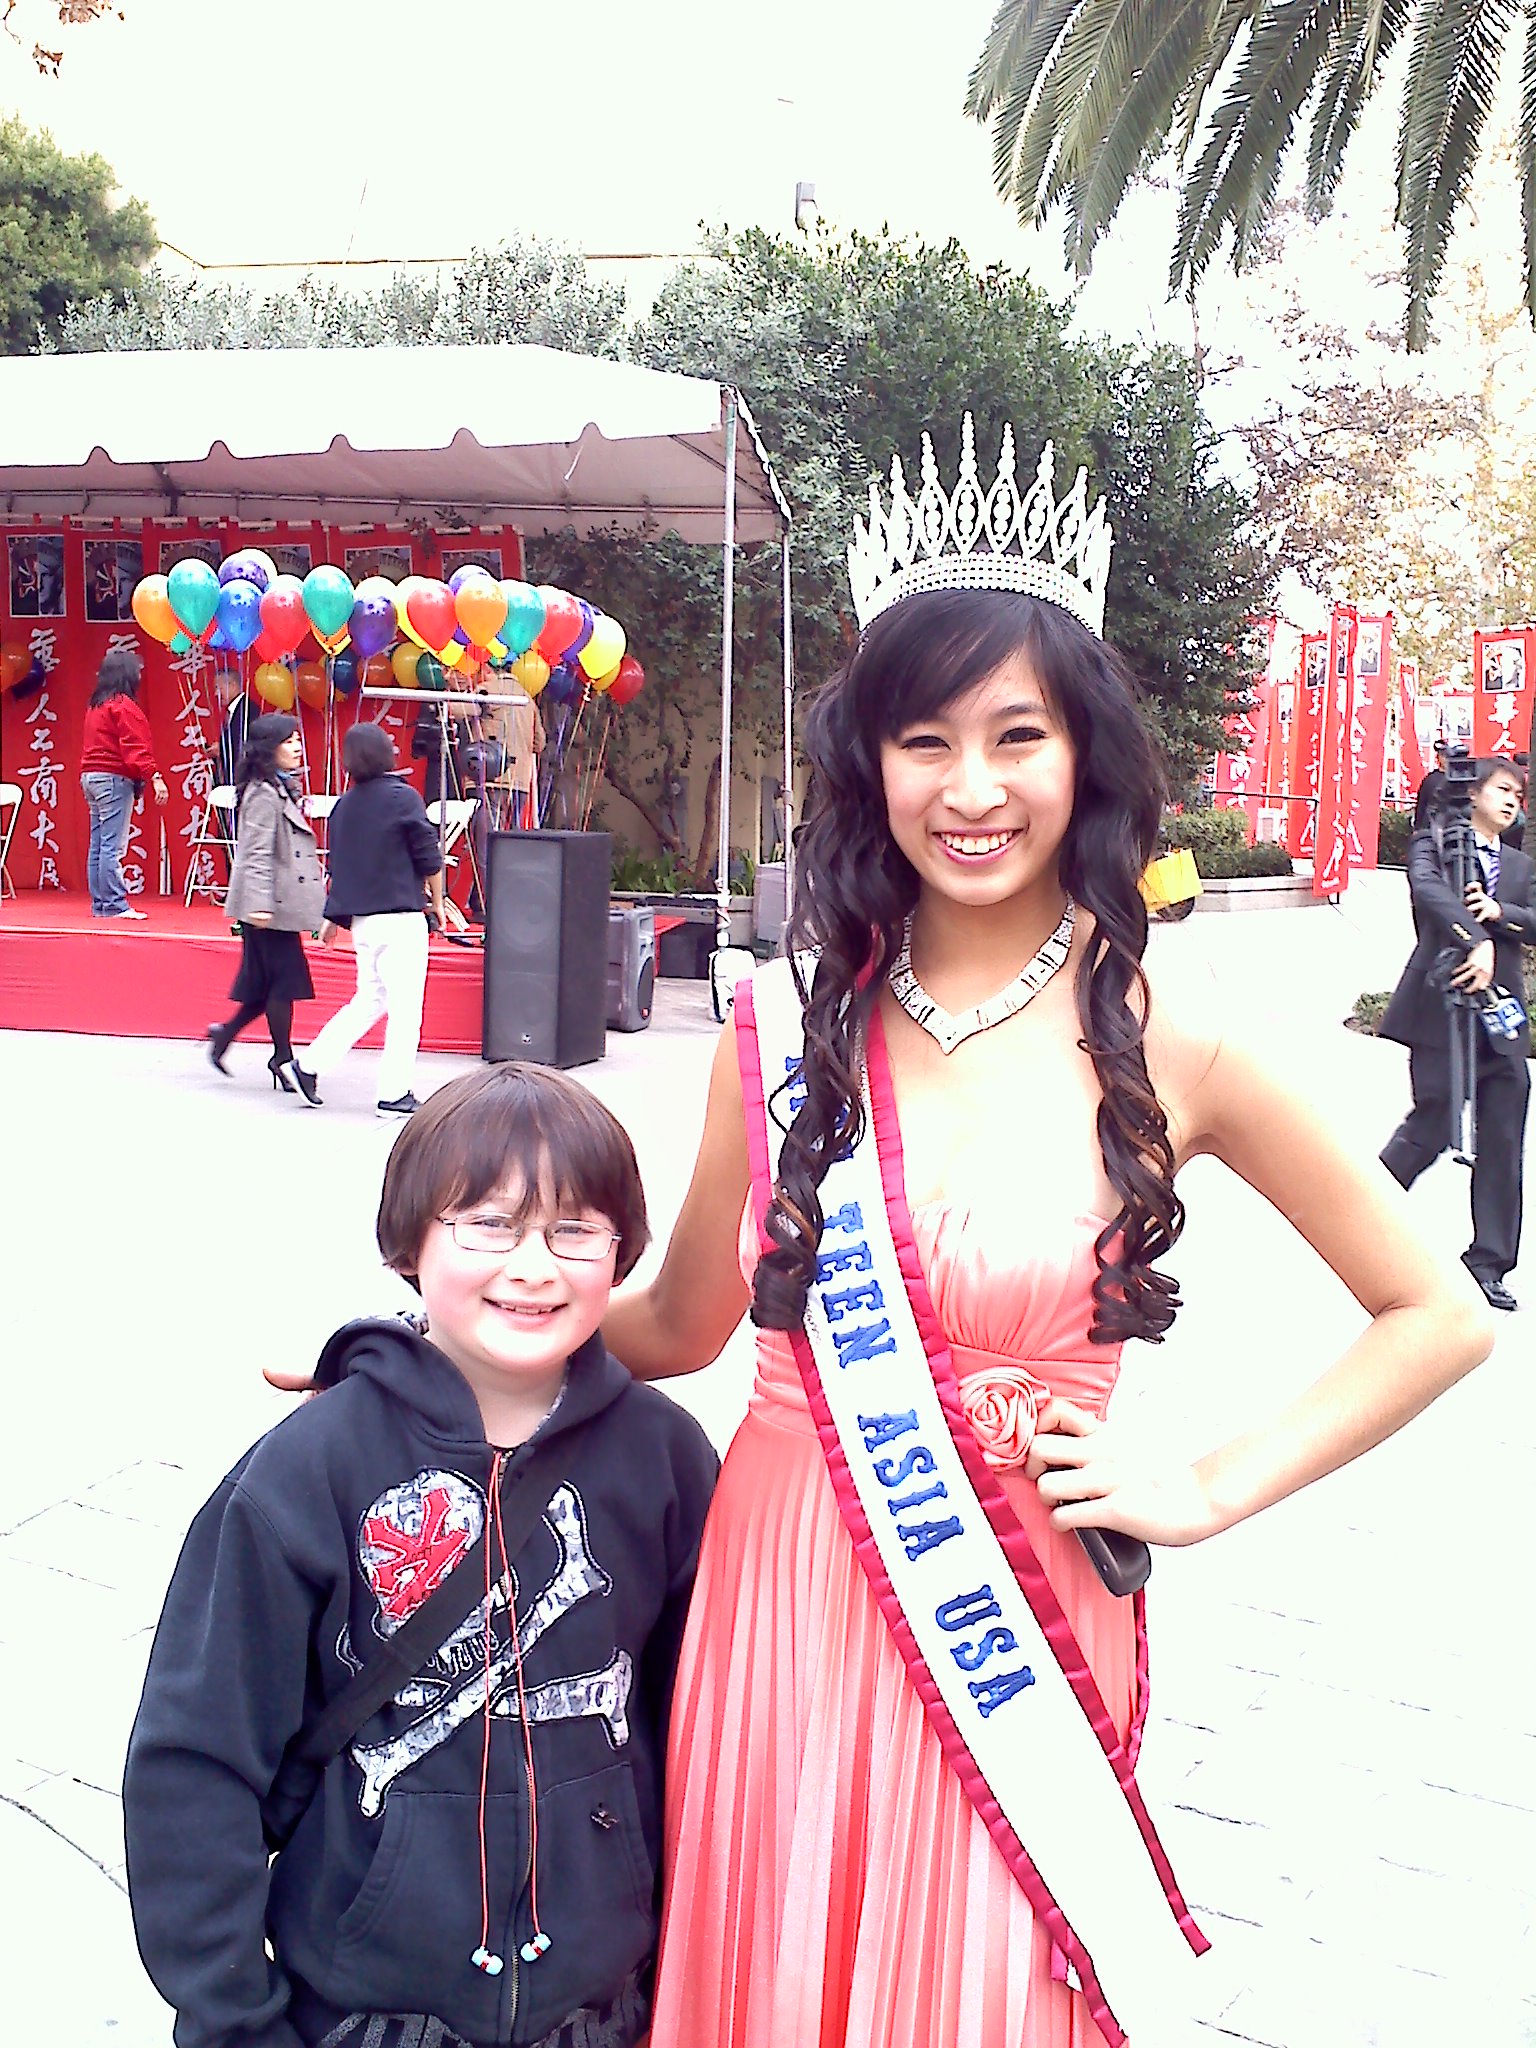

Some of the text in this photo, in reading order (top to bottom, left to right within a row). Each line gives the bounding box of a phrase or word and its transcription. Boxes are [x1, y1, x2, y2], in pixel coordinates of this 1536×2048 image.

[815, 1201, 898, 1370] TEEN
[857, 1408, 965, 1562] ASIA
[935, 1584, 1036, 1719] USA
